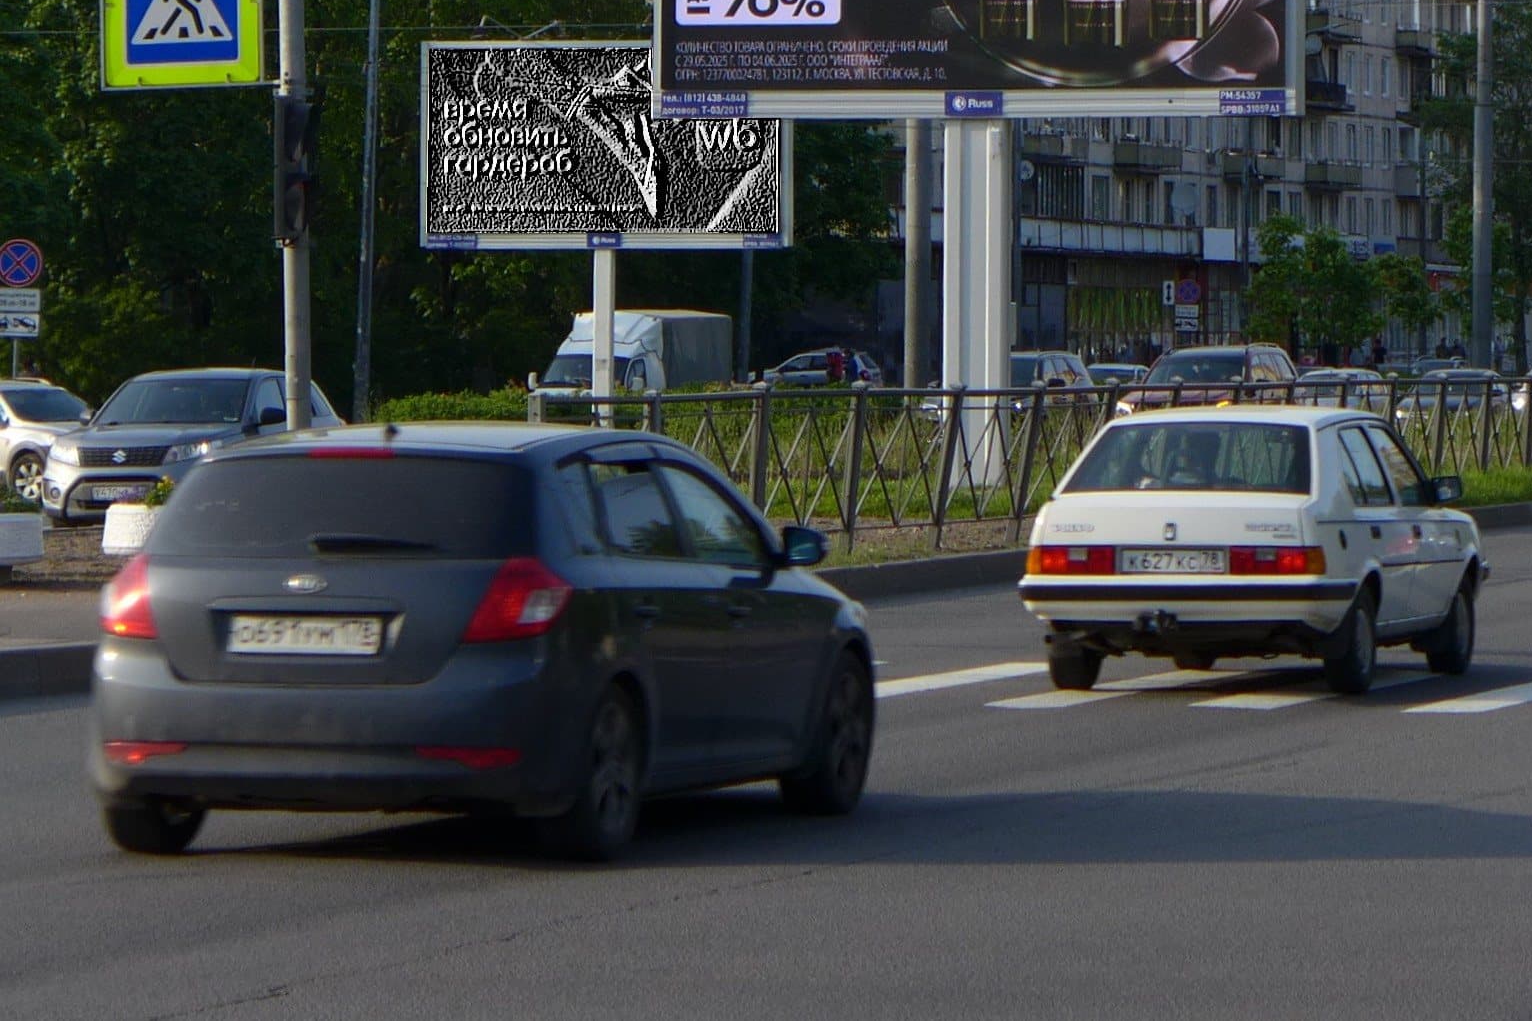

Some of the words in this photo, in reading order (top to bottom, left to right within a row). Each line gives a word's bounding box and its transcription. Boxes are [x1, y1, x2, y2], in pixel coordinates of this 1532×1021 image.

[676, 40, 732, 53] КОЛИЧЕСТВО
[734, 40, 765, 53] ТОВАРА
[827, 40, 857, 53] СРОКИ
[858, 40, 917, 53] ПРОВЕДЕНИЯ
[917, 40, 949, 53] АКЦИИ
[737, 55, 751, 67] ПО
[443, 98, 528, 127] время
[967, 98, 994, 108] Russ
[443, 120, 568, 148] обновить
[443, 147, 573, 180] гардероб
